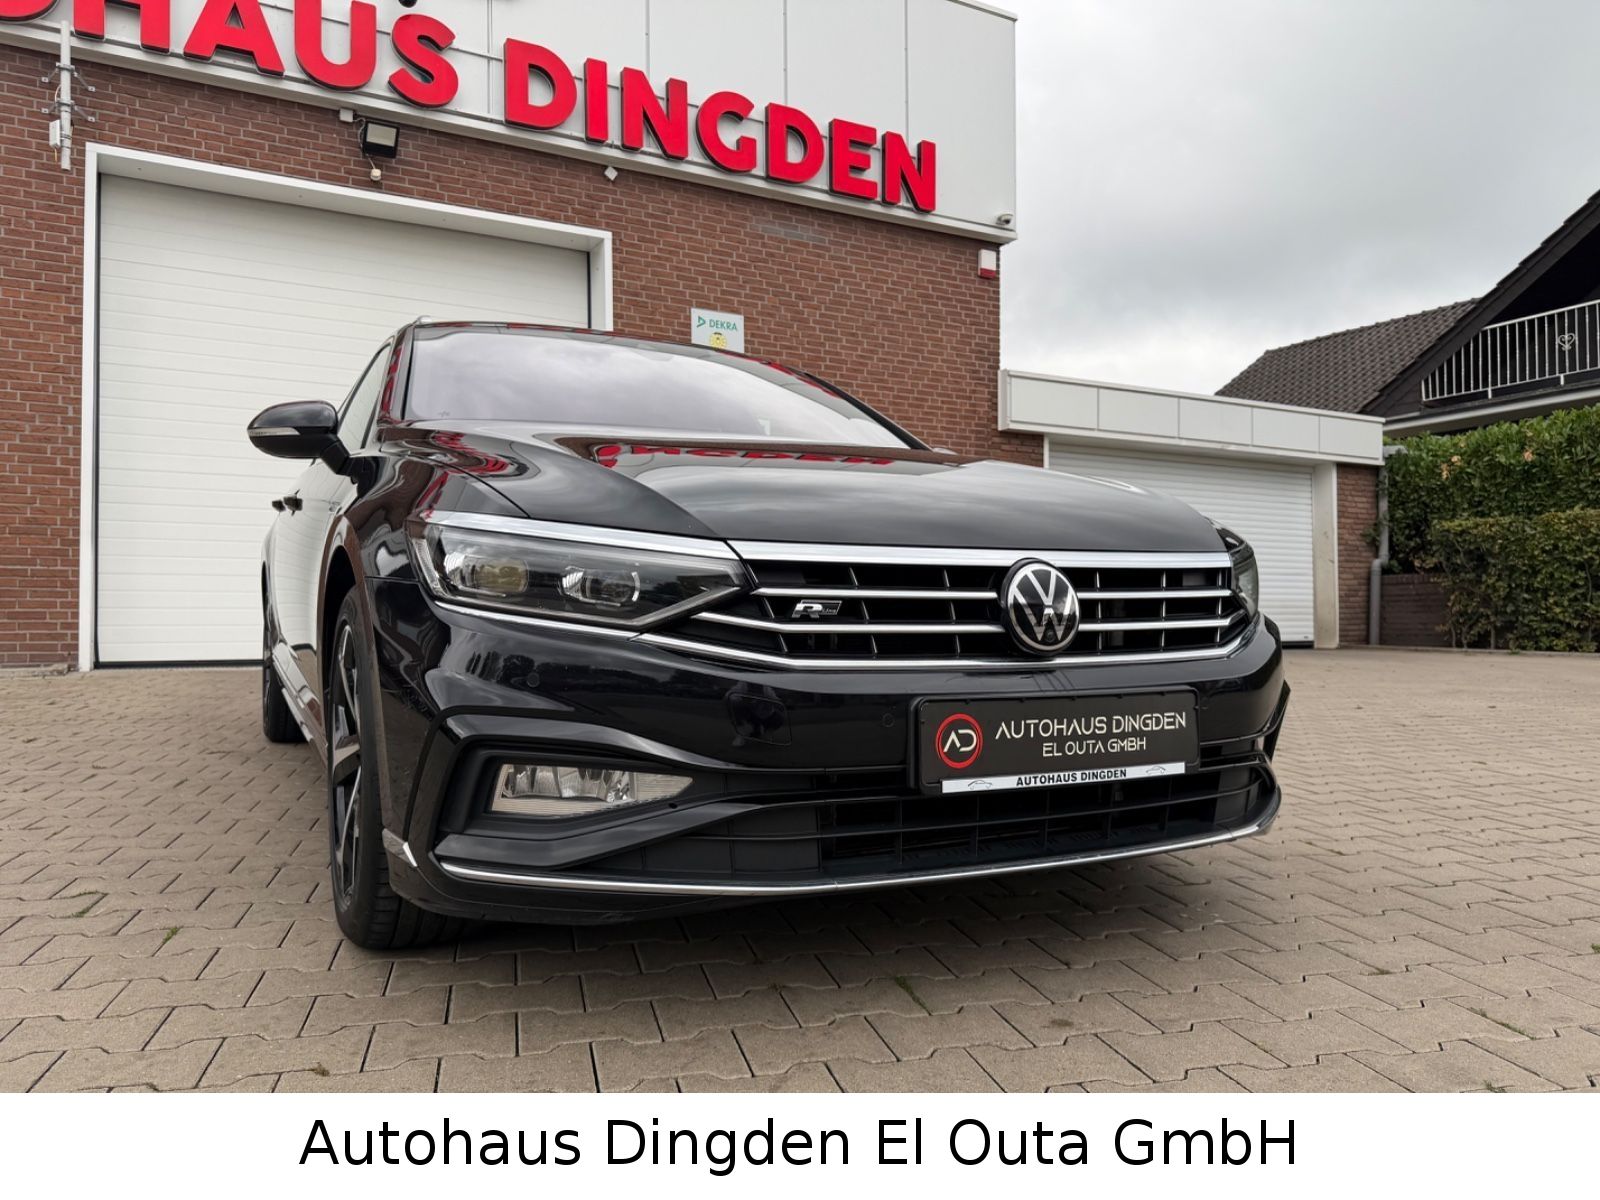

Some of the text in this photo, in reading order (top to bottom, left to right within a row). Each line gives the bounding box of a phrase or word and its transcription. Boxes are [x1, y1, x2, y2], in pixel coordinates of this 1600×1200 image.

[503, 38, 936, 213] DINGDEN
[709, 319, 738, 331] DEKRA
[995, 711, 1186, 740] AUTOHAUS DINGDEN
[943, 729, 977, 752] AD
[1042, 737, 1147, 757] EL OUTA GMBH
[1016, 768, 1127, 786] AUTOHAUS DINGDEN
